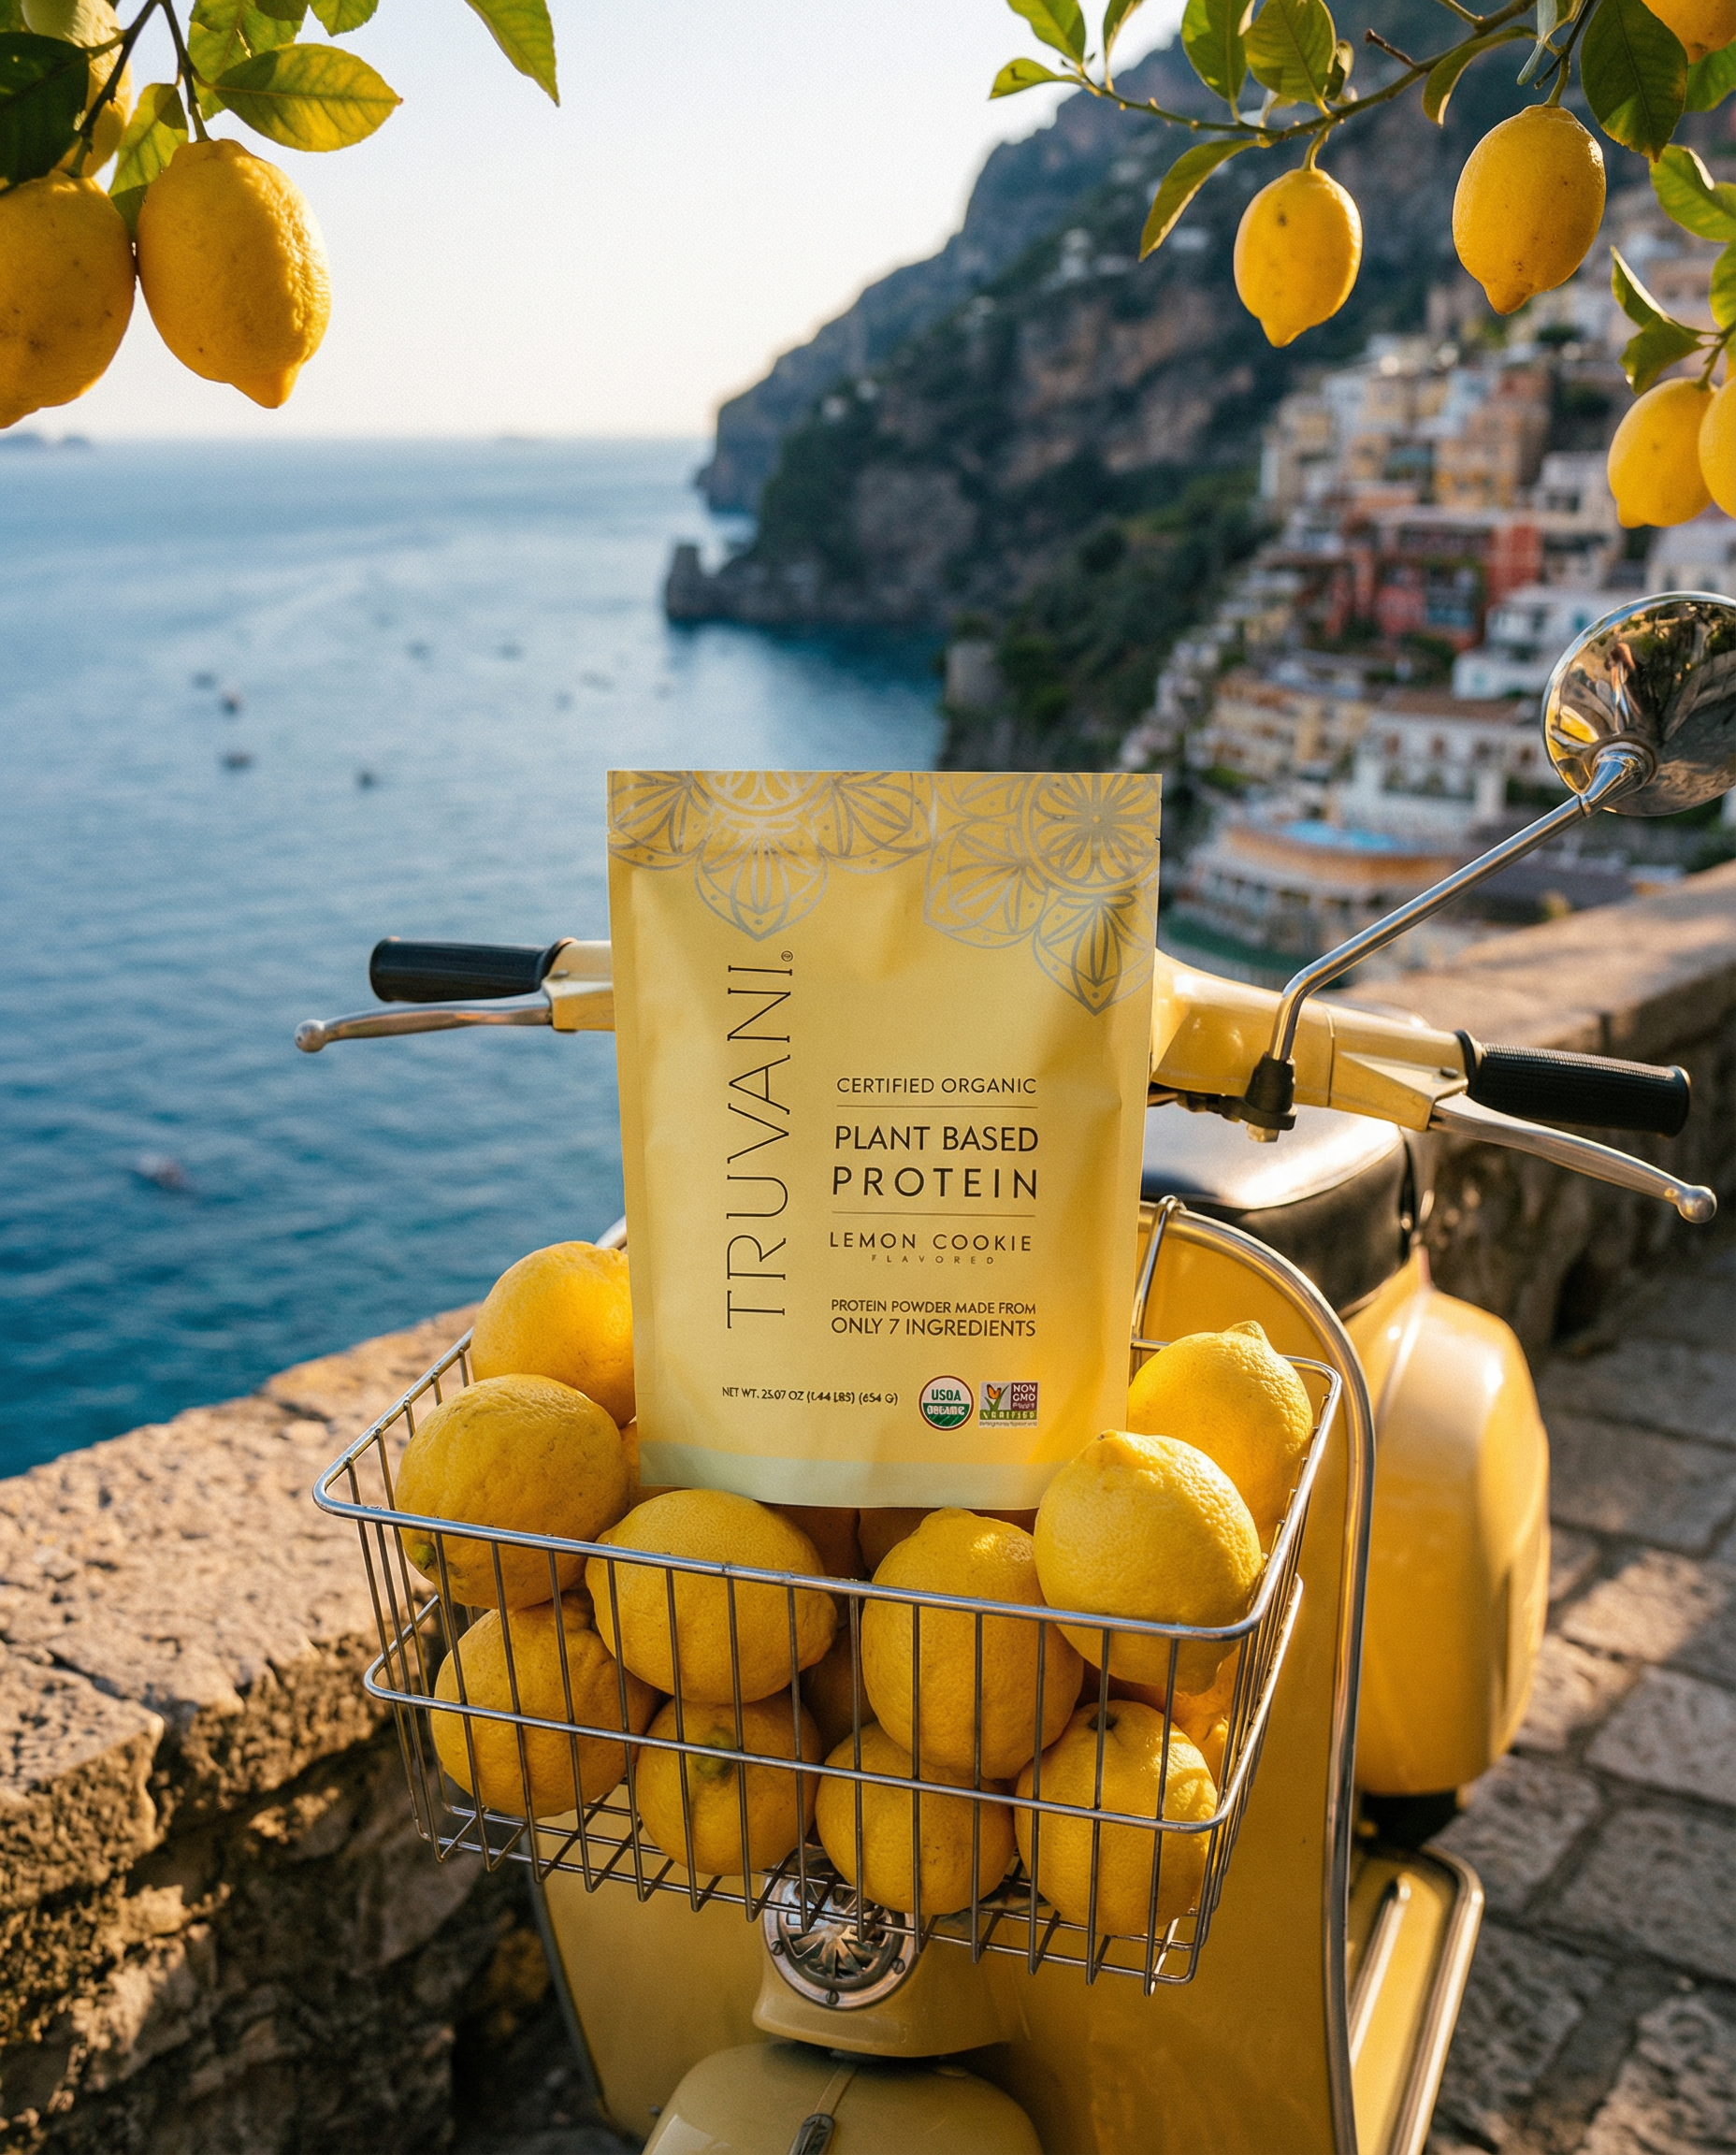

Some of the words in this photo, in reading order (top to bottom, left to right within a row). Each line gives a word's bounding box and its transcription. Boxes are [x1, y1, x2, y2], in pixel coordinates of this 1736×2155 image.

[836, 1078, 934, 1093] CERTIFIED
[941, 1078, 1036, 1094] ORGANIC
[835, 1125, 931, 1150] PLANT
[943, 1125, 1039, 1151] BASED
[832, 1165, 1036, 1200] PROTEIN
[830, 1232, 916, 1249] LEMON
[933, 1234, 1032, 1251] COOKIE
[871, 1254, 994, 1265] FLAVORED
[831, 1299, 887, 1312] PROTEIN
[891, 1300, 951, 1313] POWDER
[955, 1302, 995, 1314] MADE
[999, 1302, 1036, 1315] FROM
[831, 1317, 883, 1335] ONLY
[889, 1318, 901, 1335] 7
[905, 1318, 1036, 1337] INGREDIENTS
[722, 1387, 739, 1397] NET
[742, 1388, 760, 1398] WT.
[788, 1390, 804, 1401] OZ
[1013, 1384, 1035, 1393] NON
